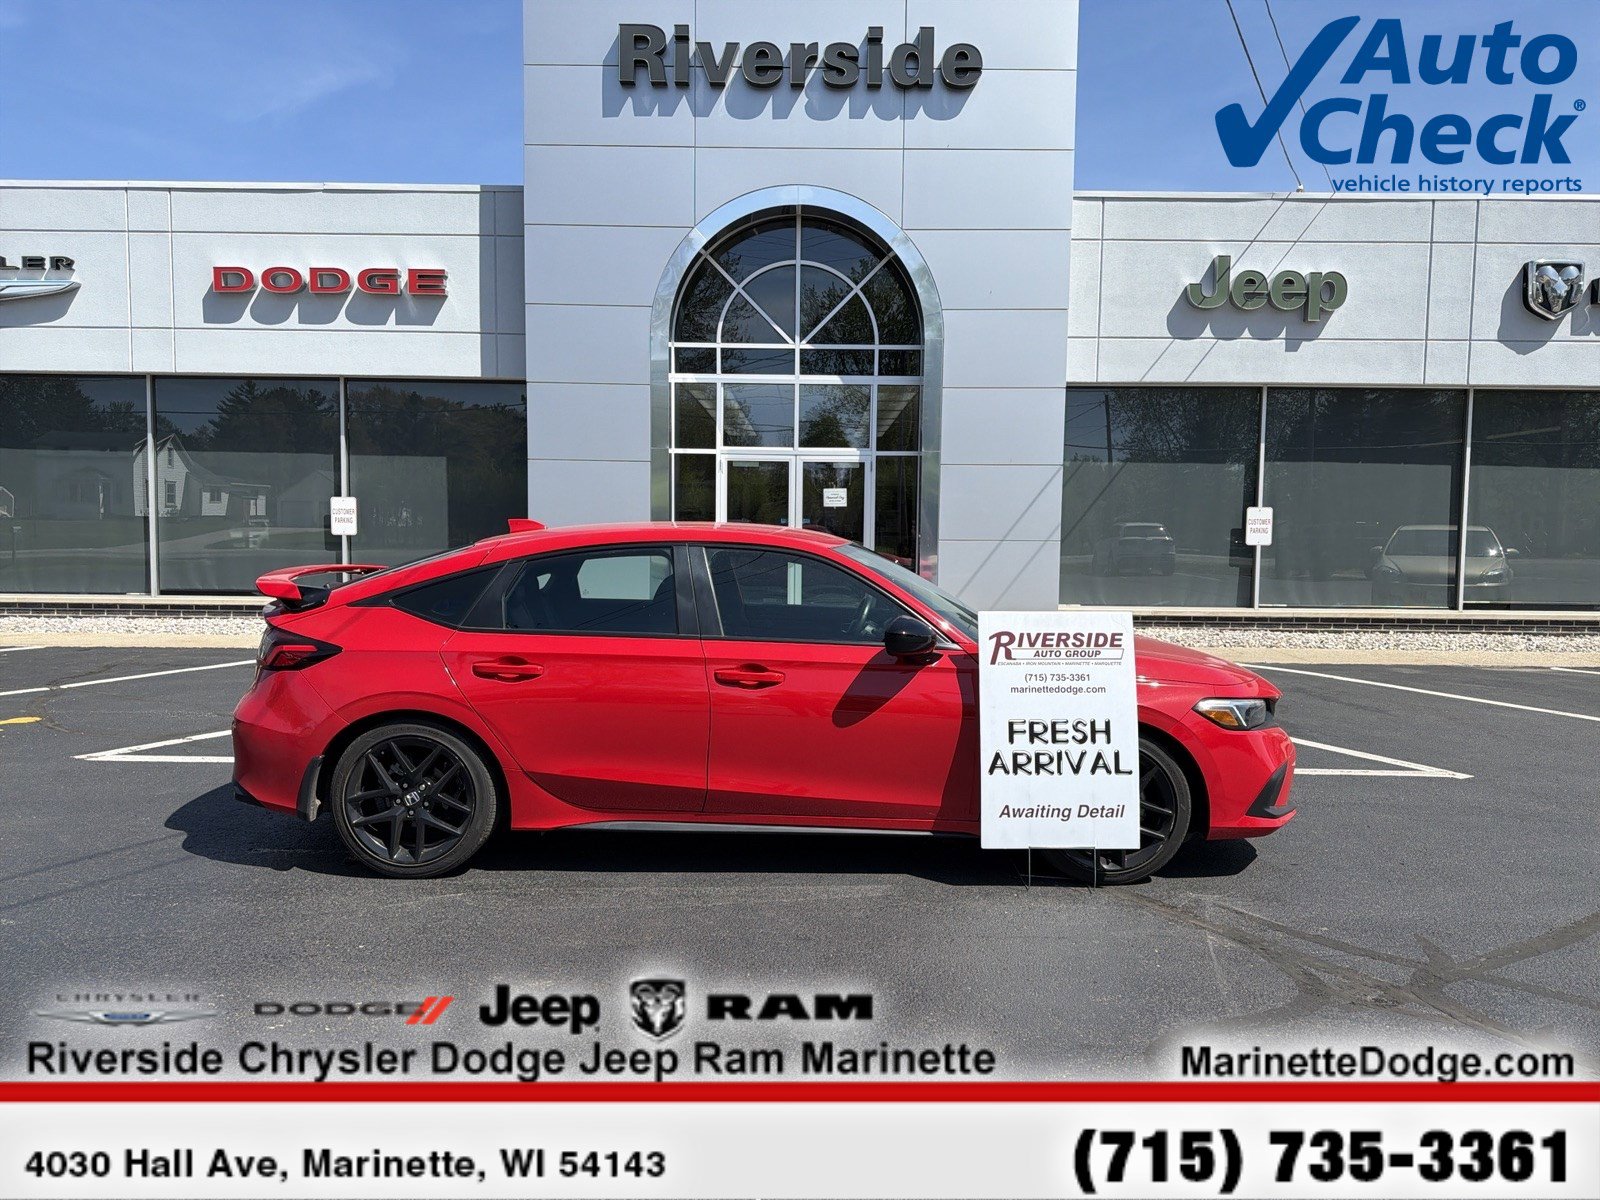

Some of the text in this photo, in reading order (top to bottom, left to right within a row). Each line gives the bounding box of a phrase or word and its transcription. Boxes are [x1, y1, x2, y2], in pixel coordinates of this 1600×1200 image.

[618, 23, 983, 91] Riverside
[212, 266, 450, 297] DODGE
[1187, 255, 1348, 322] Jeep
[988, 631, 1123, 666] RIVERSIDE
[1033, 650, 1102, 658] AUTO GROUP
[1010, 685, 1106, 695] marinettedodge.com
[1024, 673, 1091, 683] (715) 735-3361
[1008, 718, 1111, 745] FRESH
[988, 749, 1133, 776] ARRIVAL
[999, 804, 1125, 822] Awaiting Detail
